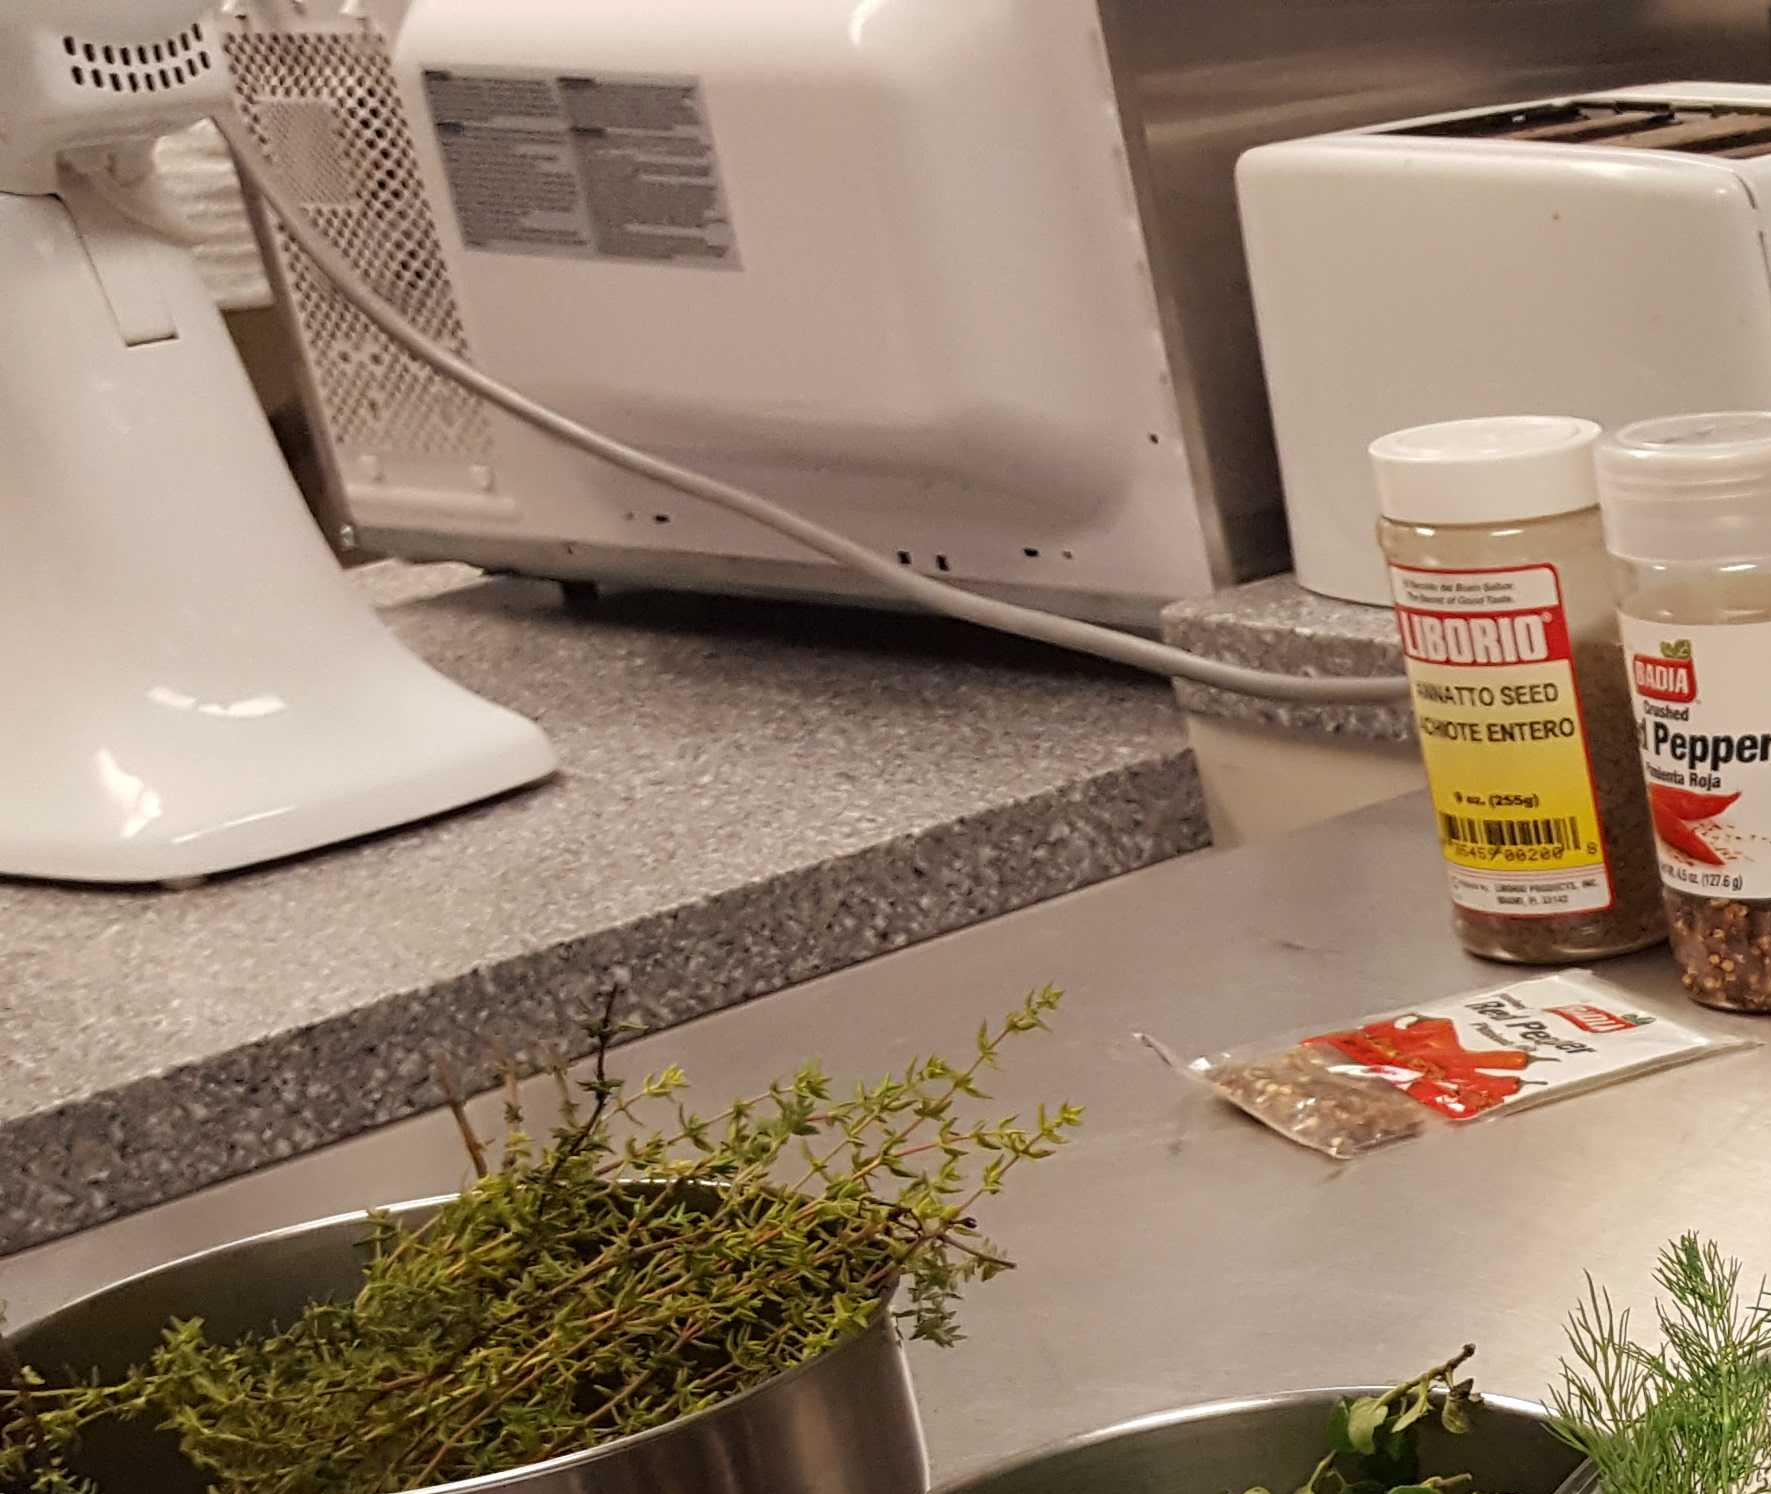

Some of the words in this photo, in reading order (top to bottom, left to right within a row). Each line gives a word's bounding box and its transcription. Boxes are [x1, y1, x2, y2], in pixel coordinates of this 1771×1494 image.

[1634, 660, 1690, 694] BADIA
[1500, 682, 1559, 706] SEED
[1487, 717, 1575, 742] ENTERO
[1689, 772, 1721, 791] Roja
[1488, 793, 1541, 809] (255g)
